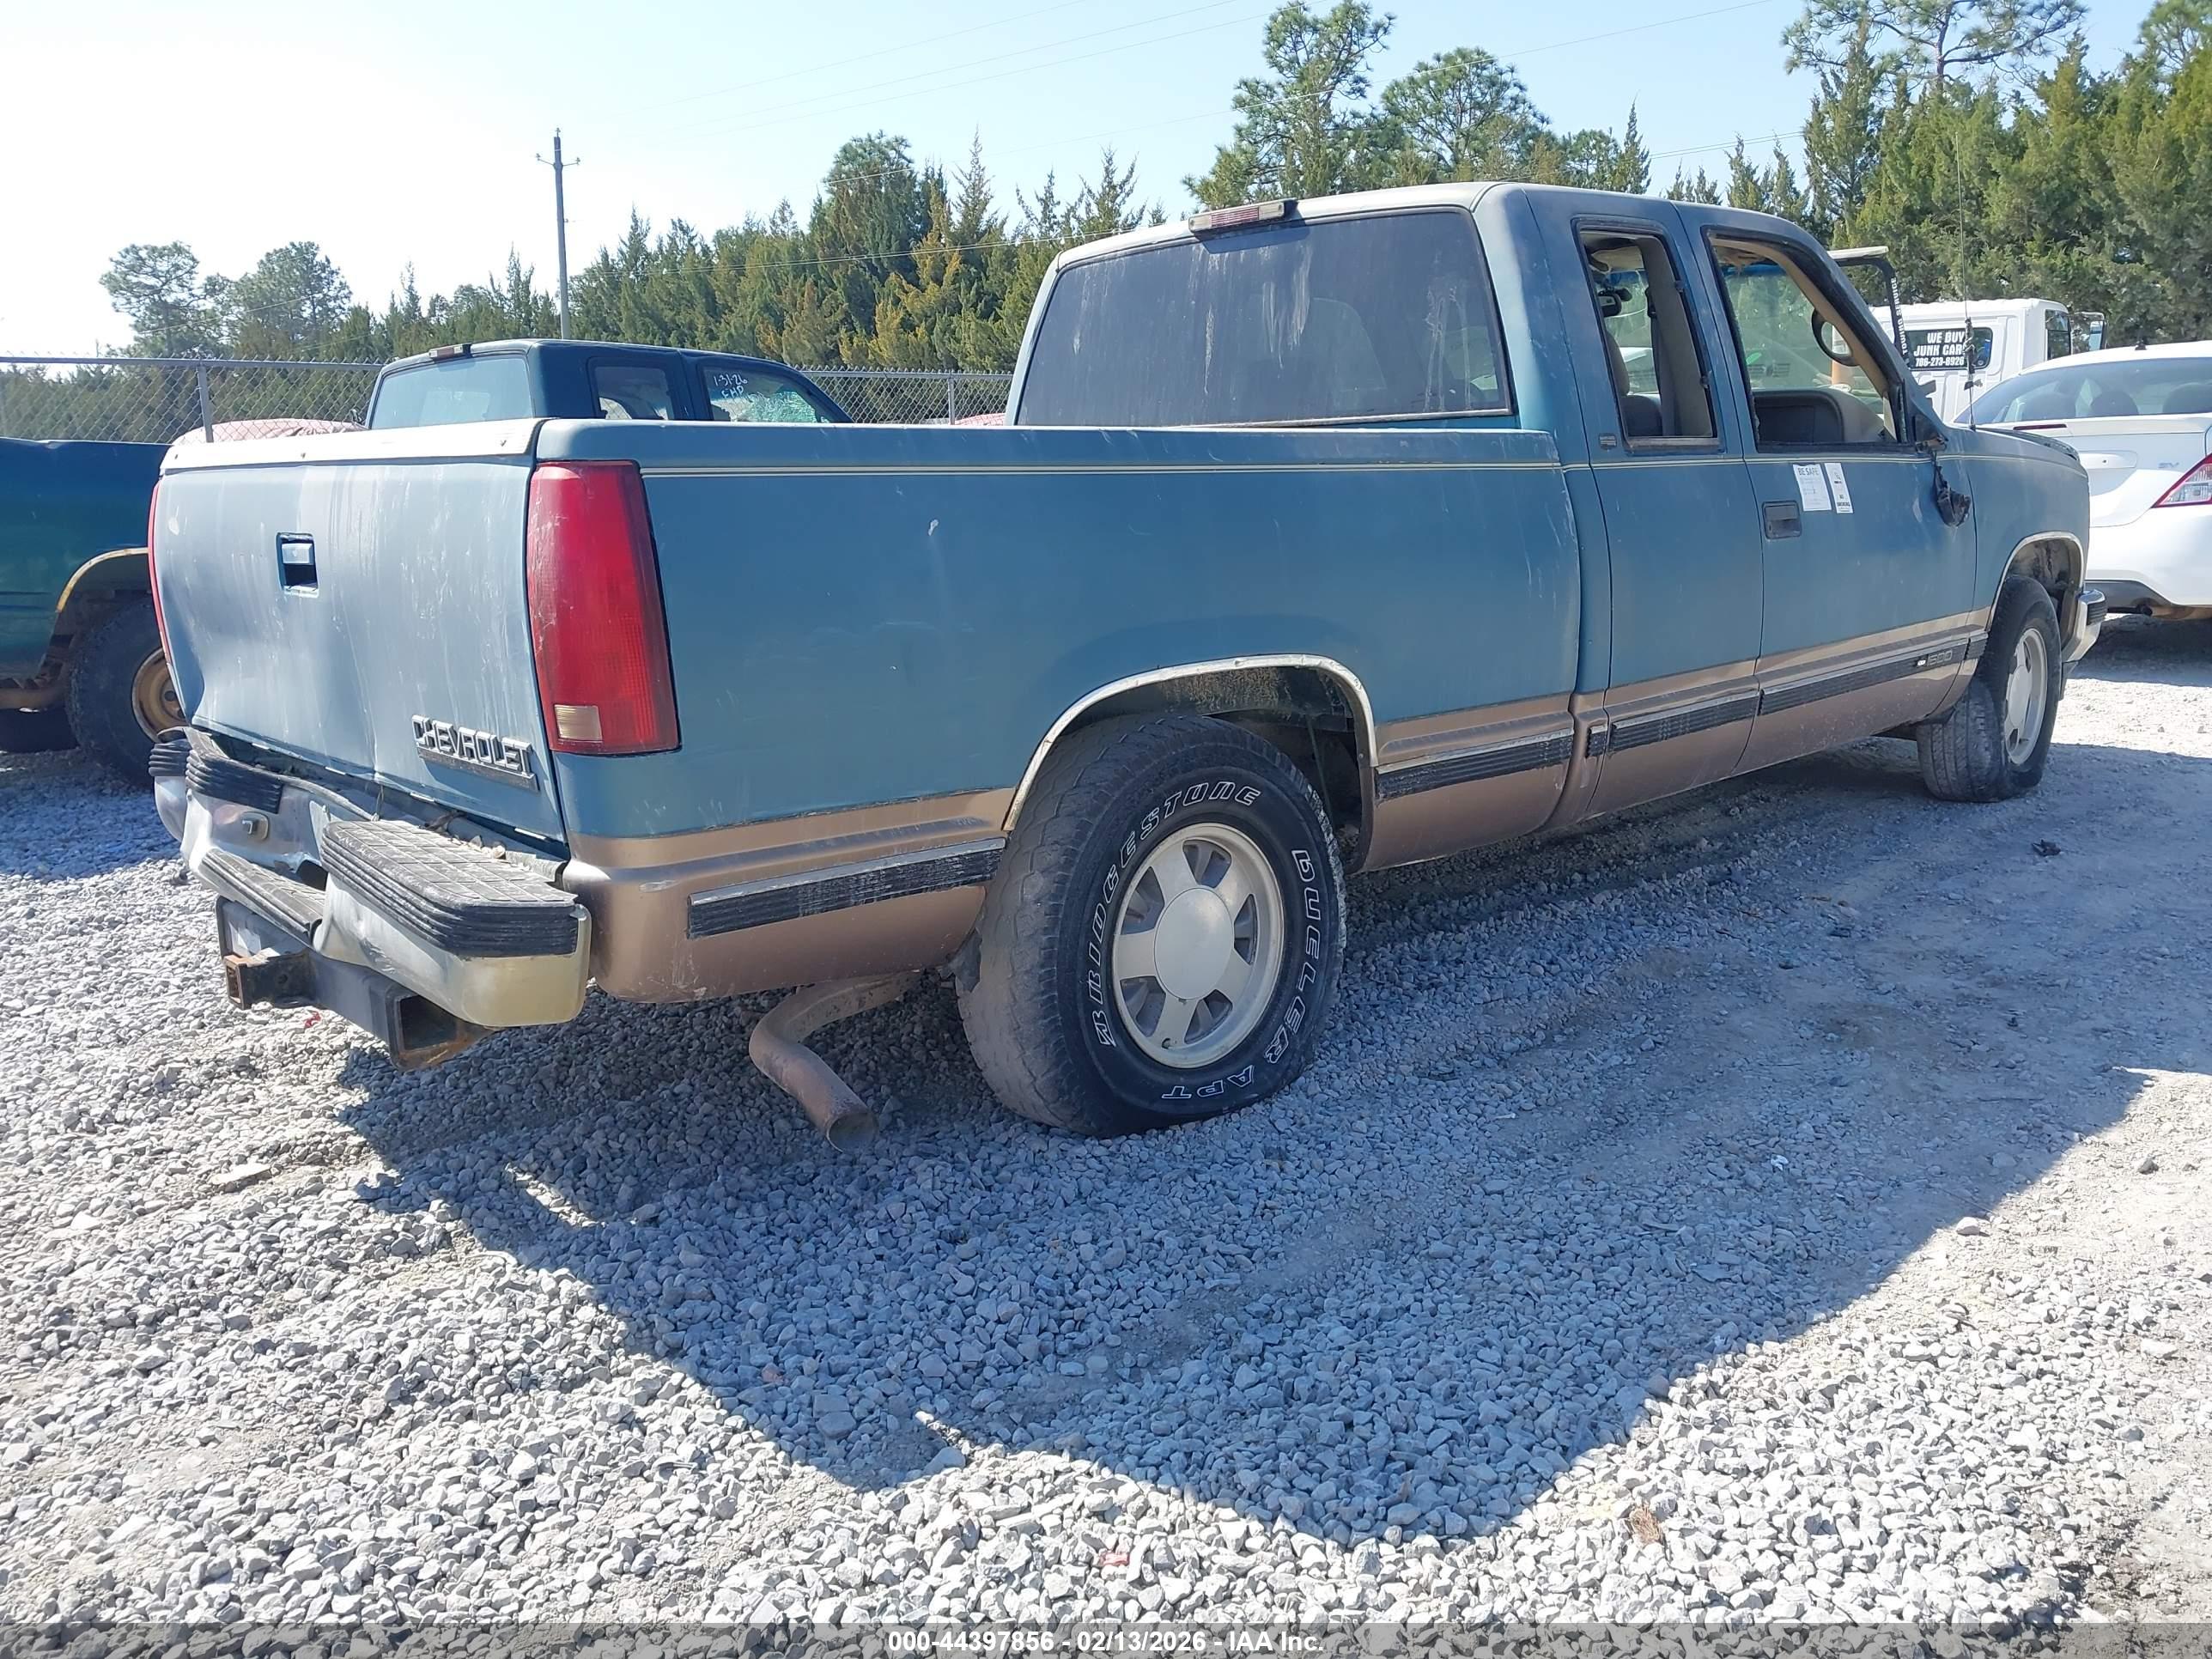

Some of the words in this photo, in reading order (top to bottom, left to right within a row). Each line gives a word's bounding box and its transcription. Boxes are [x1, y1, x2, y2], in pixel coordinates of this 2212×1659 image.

[1890, 276, 1902, 317] SERVICE
[1913, 345, 1940, 356] JUNK
[1927, 332, 1942, 344] WE
[1944, 331, 1965, 343] BUY
[1797, 467, 1806, 476] BE
[1806, 467, 1820, 476] SAFE
[1927, 649, 1953, 666] 1500
[412, 714, 532, 776] CHEVROLET
[1088, 781, 1261, 1048] BRIDGESTONE
[1264, 848, 1322, 1065] DUELER
[1161, 1064, 1255, 1100] APT
